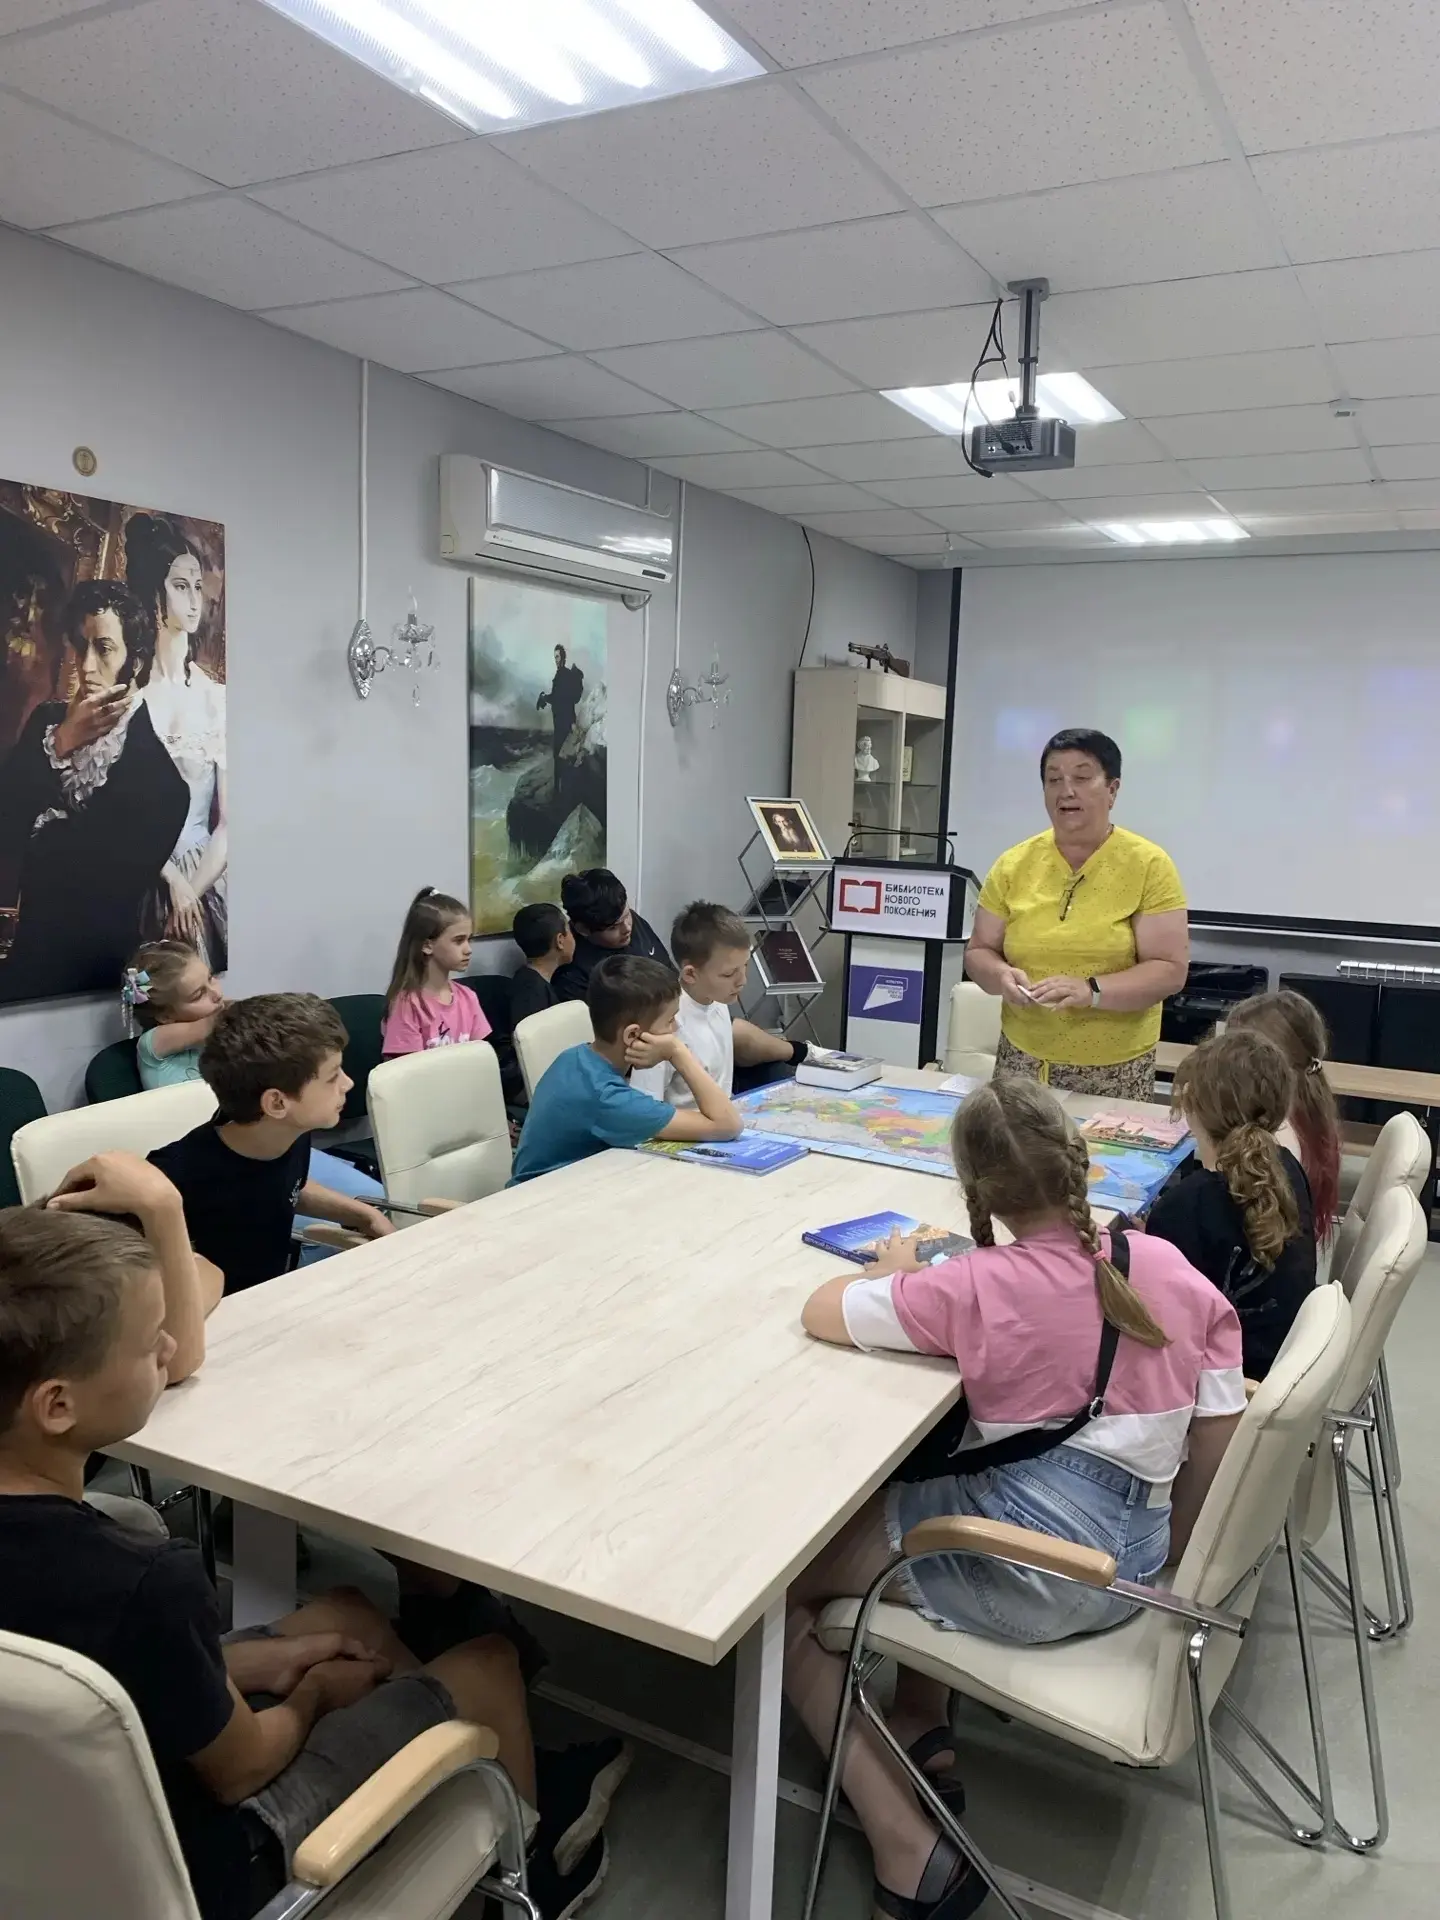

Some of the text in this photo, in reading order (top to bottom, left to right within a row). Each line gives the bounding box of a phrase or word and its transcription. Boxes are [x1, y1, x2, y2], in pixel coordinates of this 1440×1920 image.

[885, 884, 944, 896] БИБЛИОТЕКА
[885, 894, 920, 905] НОВОГО
[884, 906, 936, 918] ПОКОЛЕНИЯ
